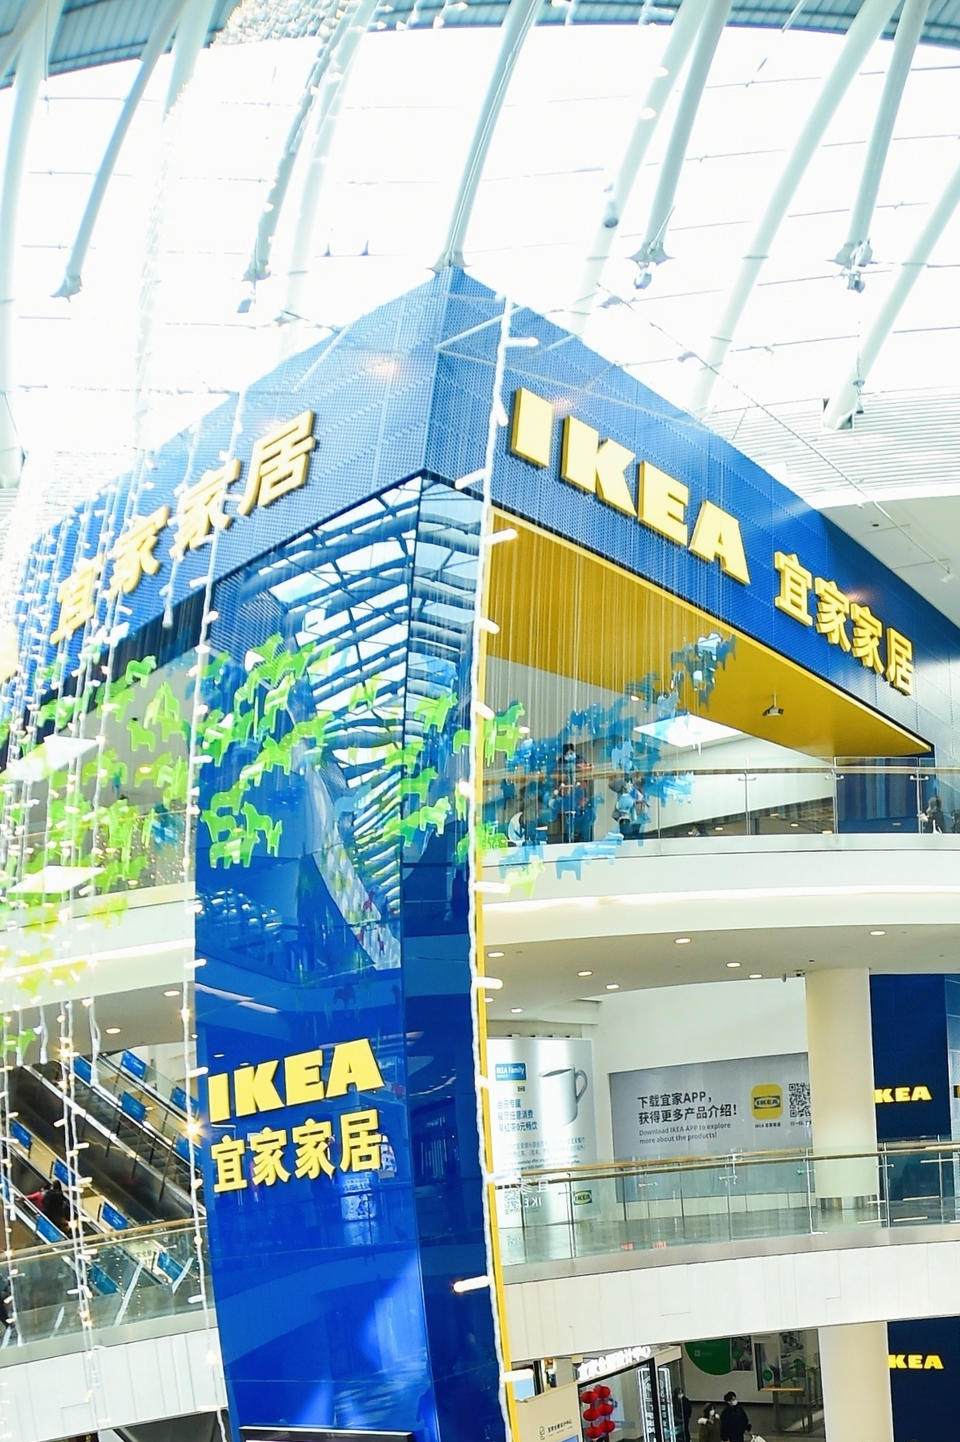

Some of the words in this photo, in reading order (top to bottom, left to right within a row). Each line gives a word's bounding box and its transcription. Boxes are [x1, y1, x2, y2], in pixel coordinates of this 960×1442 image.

[50, 409, 315, 645] 宜家家居
[511, 387, 750, 584] IKEA
[774, 552, 914, 696] 宜家家居
[208, 1038, 385, 1124] IKEA
[873, 1086, 933, 1104] KEA
[211, 1109, 382, 1193] 宜家家居
[639, 1126, 669, 1137] Download
[670, 1125, 685, 1134] IKEA
[685, 1124, 698, 1132] APP
[707, 1121, 731, 1132] explore
[639, 1136, 655, 1145] more
[656, 1133, 675, 1143] about
[675, 1132, 687, 1141] the
[888, 1354, 944, 1370] KEA
